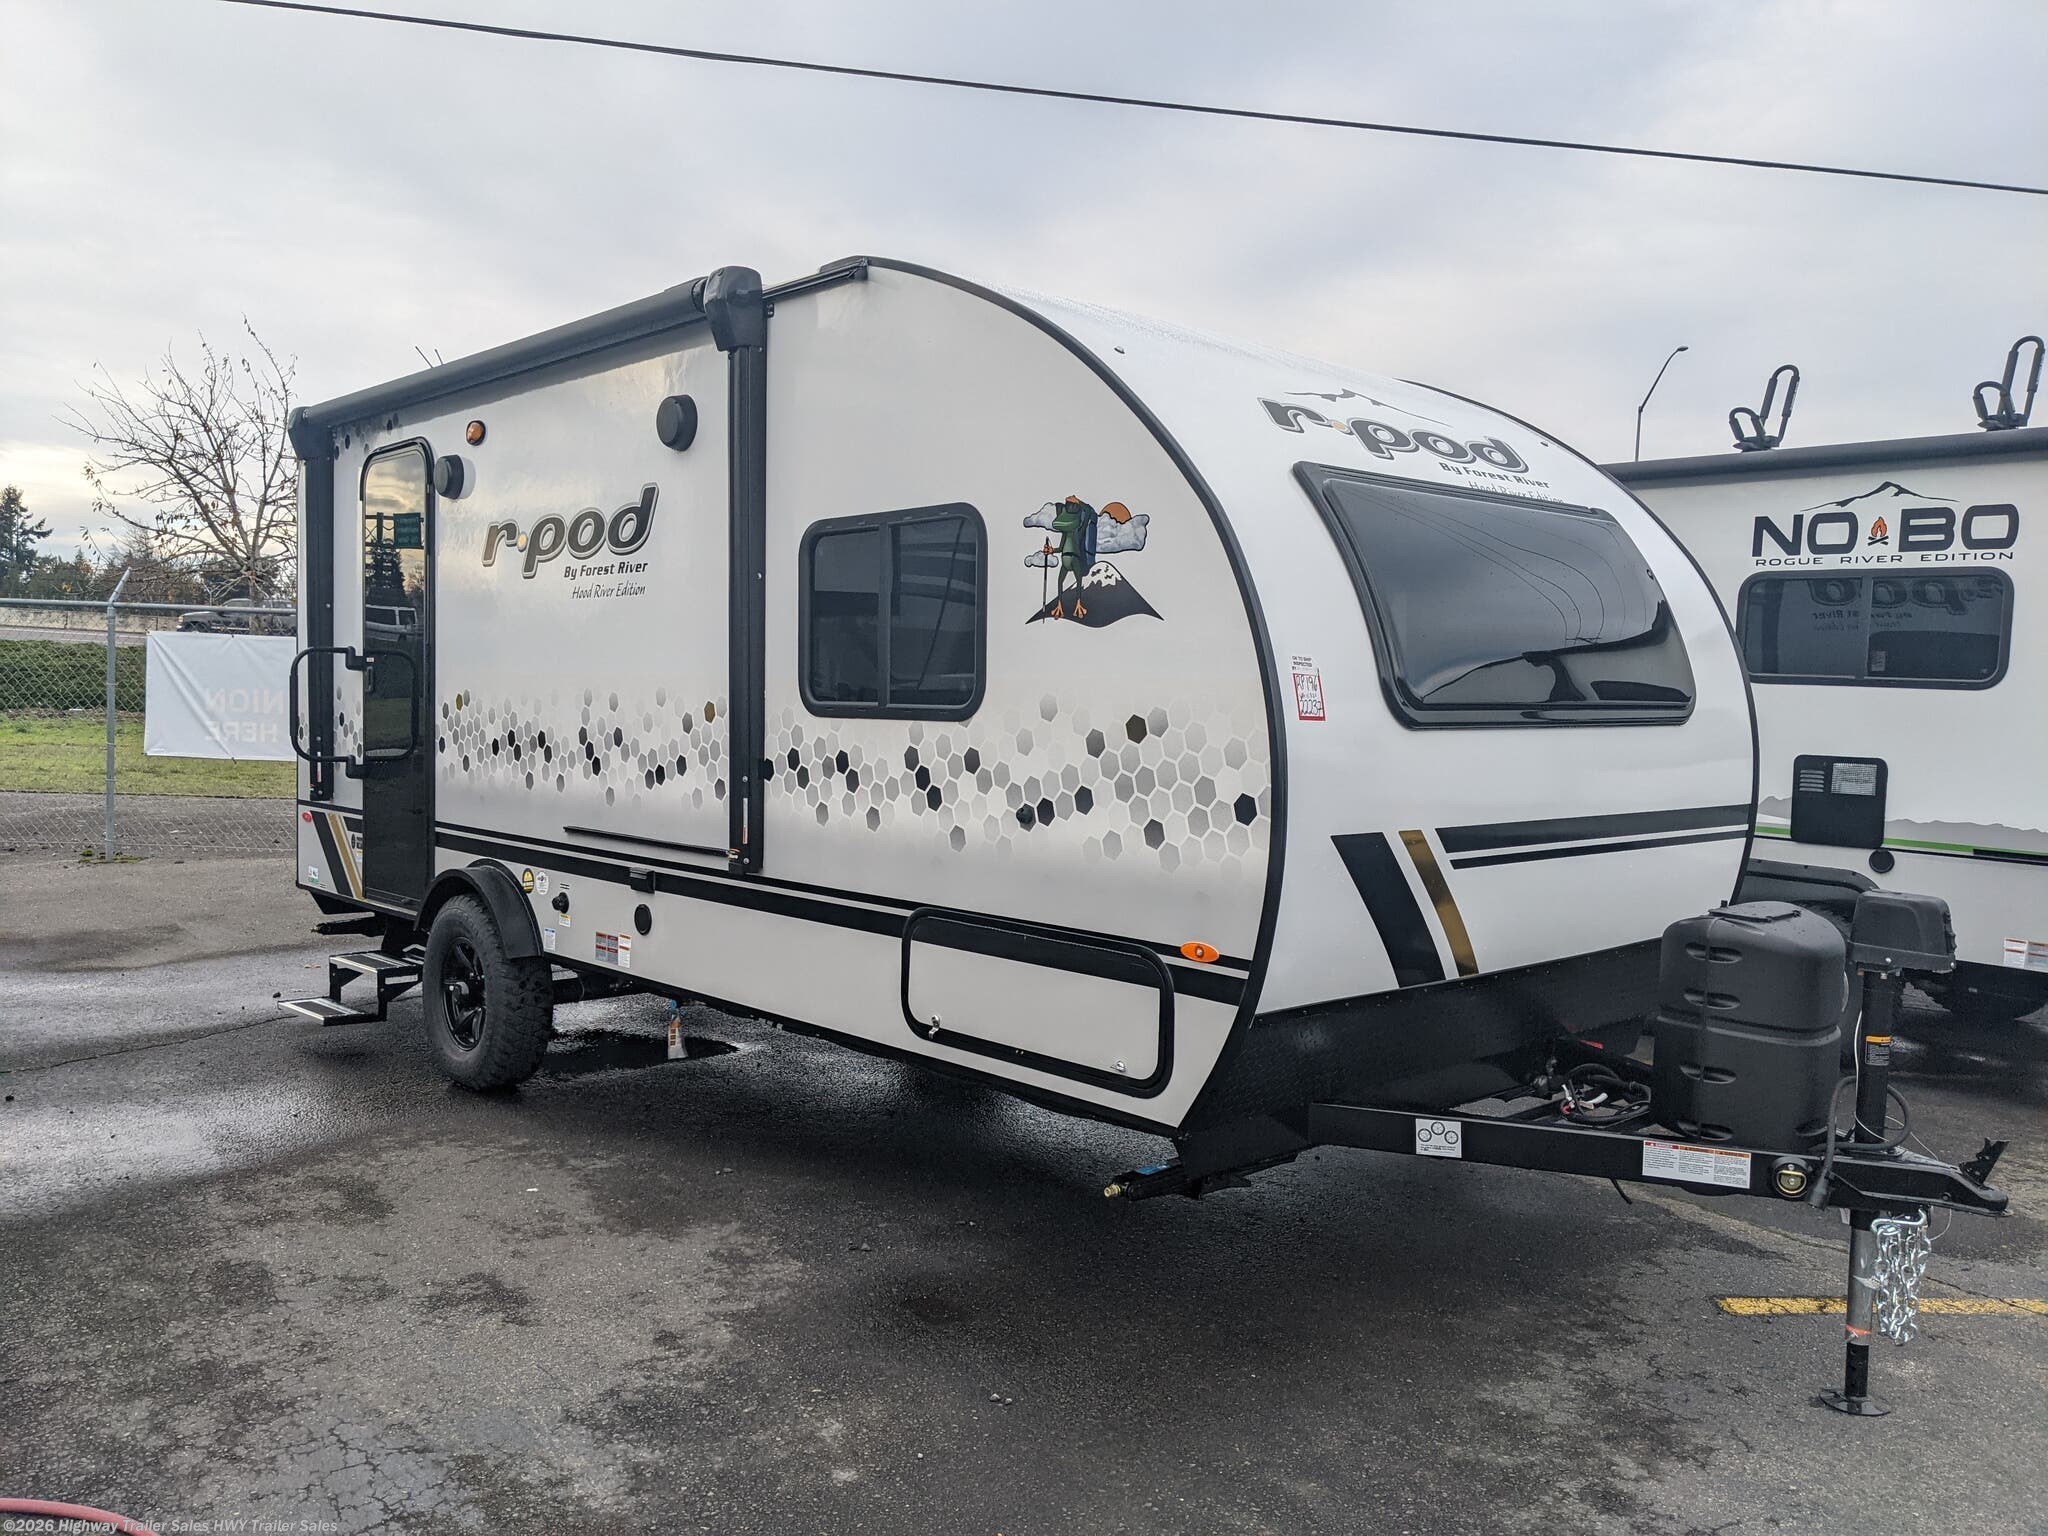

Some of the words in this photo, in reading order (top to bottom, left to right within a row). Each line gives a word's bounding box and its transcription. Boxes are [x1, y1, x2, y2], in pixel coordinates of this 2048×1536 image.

[1439, 461, 1461, 475] By
[1465, 467, 1512, 482] Forest
[1515, 474, 1550, 489] River
[1755, 556, 1823, 567] ROGUE
[1840, 554, 1903, 564] RIVER
[1920, 551, 2014, 562] EDITION
[564, 566, 577, 580] By
[580, 564, 615, 577] Forest
[618, 561, 648, 574] River
[572, 583, 594, 599] Hood
[594, 584, 615, 599] River
[616, 580, 646, 597] Edition
